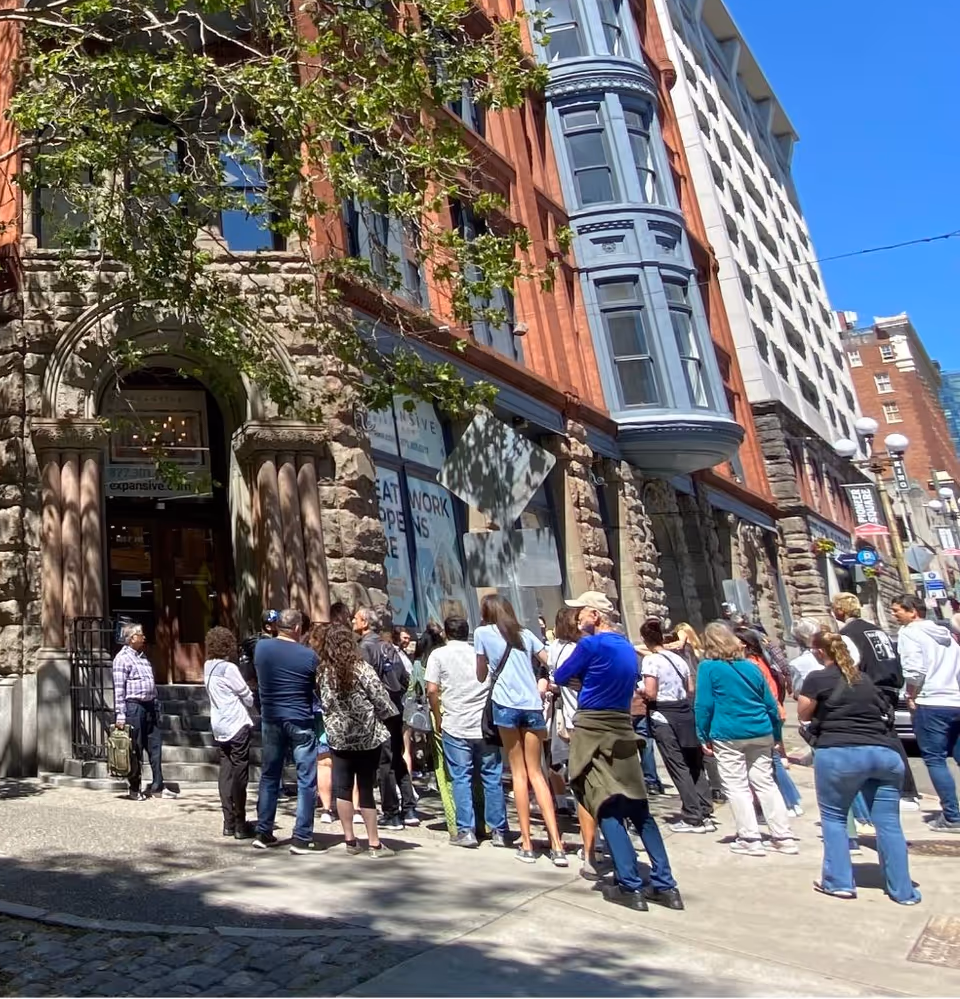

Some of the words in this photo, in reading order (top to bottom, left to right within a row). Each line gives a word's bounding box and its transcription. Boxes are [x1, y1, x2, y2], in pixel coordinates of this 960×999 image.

[109, 480, 192, 493] expansive.cm
[375, 479, 400, 505] EAT
[408, 489, 450, 518] WORK
[850, 488, 868, 523] PIONEER
[861, 487, 878, 523] SQUARE
